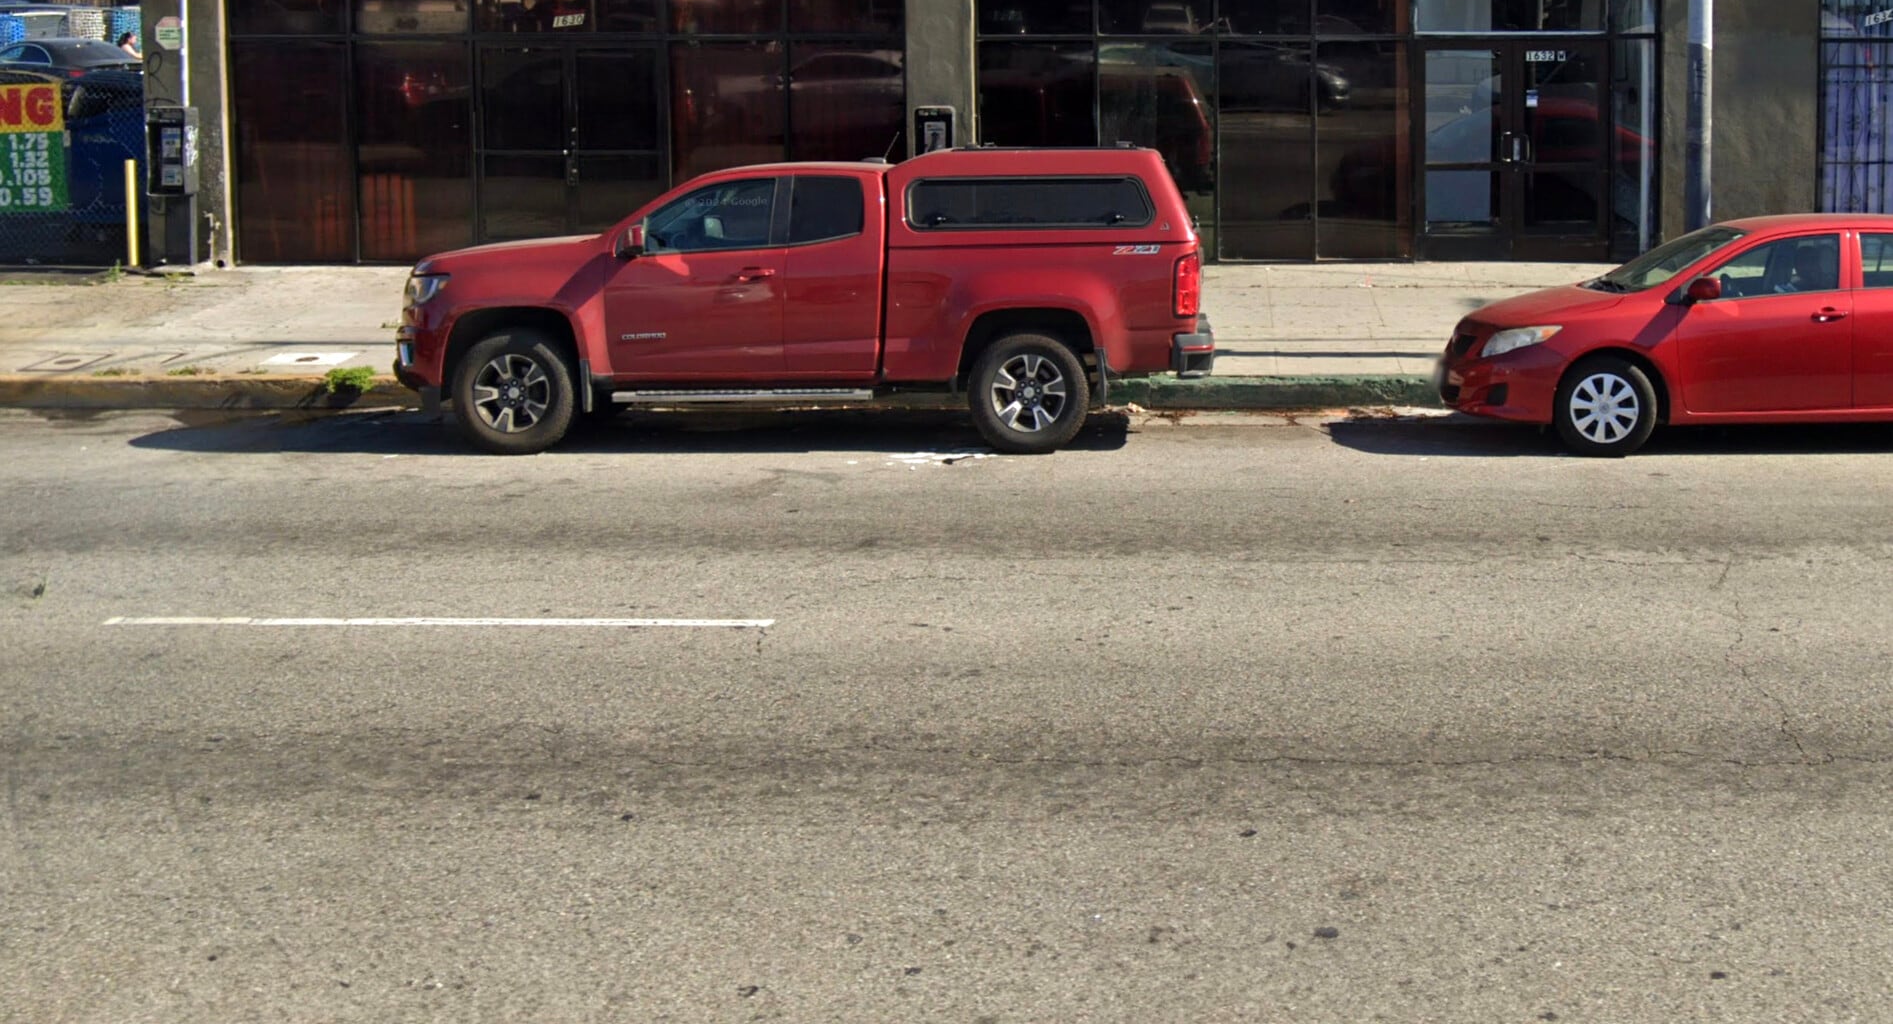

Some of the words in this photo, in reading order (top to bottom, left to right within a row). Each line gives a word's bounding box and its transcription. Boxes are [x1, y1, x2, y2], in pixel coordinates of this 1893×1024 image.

[555, 15, 583, 26] 1630
[1527, 50, 1555, 61] 1632
[9, 133, 49, 150] 1.75
